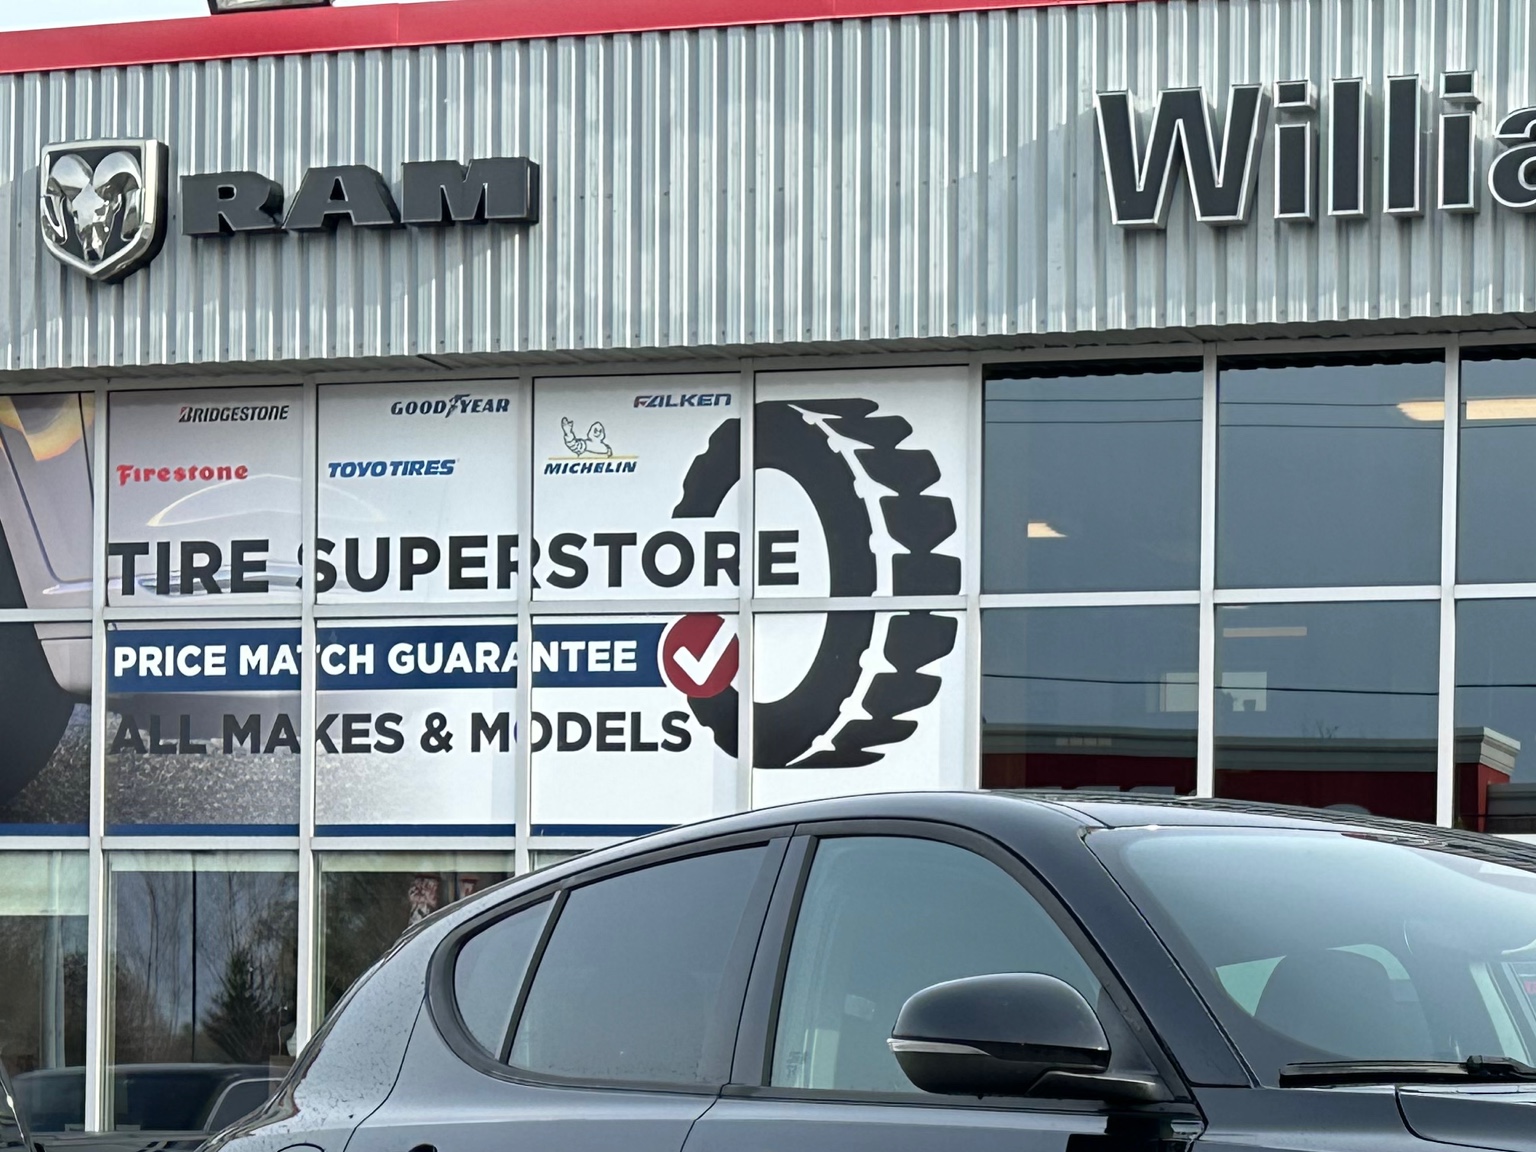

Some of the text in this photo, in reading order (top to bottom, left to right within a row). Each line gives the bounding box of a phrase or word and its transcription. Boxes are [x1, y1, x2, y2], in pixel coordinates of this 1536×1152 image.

[180, 157, 540, 236] RAM
[390, 394, 510, 418] GOODYEAR
[632, 393, 732, 409] FALKEN
[178, 405, 289, 423] BRIDGESTONE
[116, 465, 248, 486] Firestone
[328, 459, 456, 478] TOYO TIRES
[543, 461, 638, 475] MICHELIN
[108, 530, 799, 595] TIRE SUPERSTORE
[114, 645, 227, 677] PRICE
[110, 710, 692, 755] ALL MAKES & MODELS
